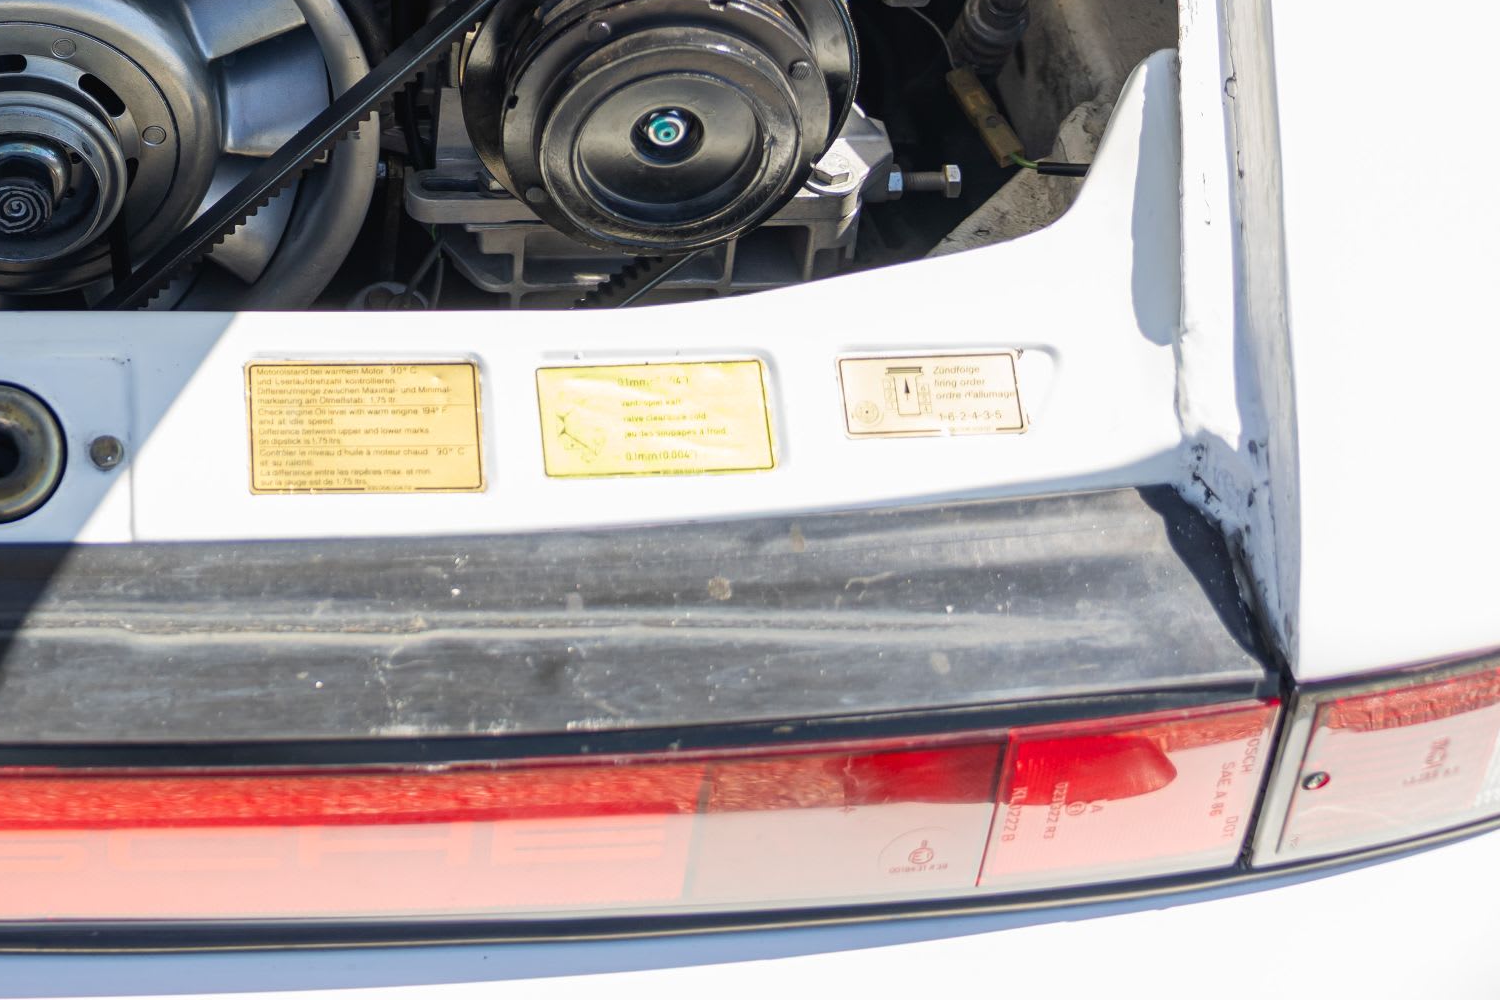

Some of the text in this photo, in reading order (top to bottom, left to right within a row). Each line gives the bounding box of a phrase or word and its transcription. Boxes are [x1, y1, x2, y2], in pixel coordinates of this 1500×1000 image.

[258, 377, 272, 385] und
[257, 387, 321, 396] Differenzmenge
[323, 387, 361, 395] zwischen
[258, 397, 303, 407] markierung
